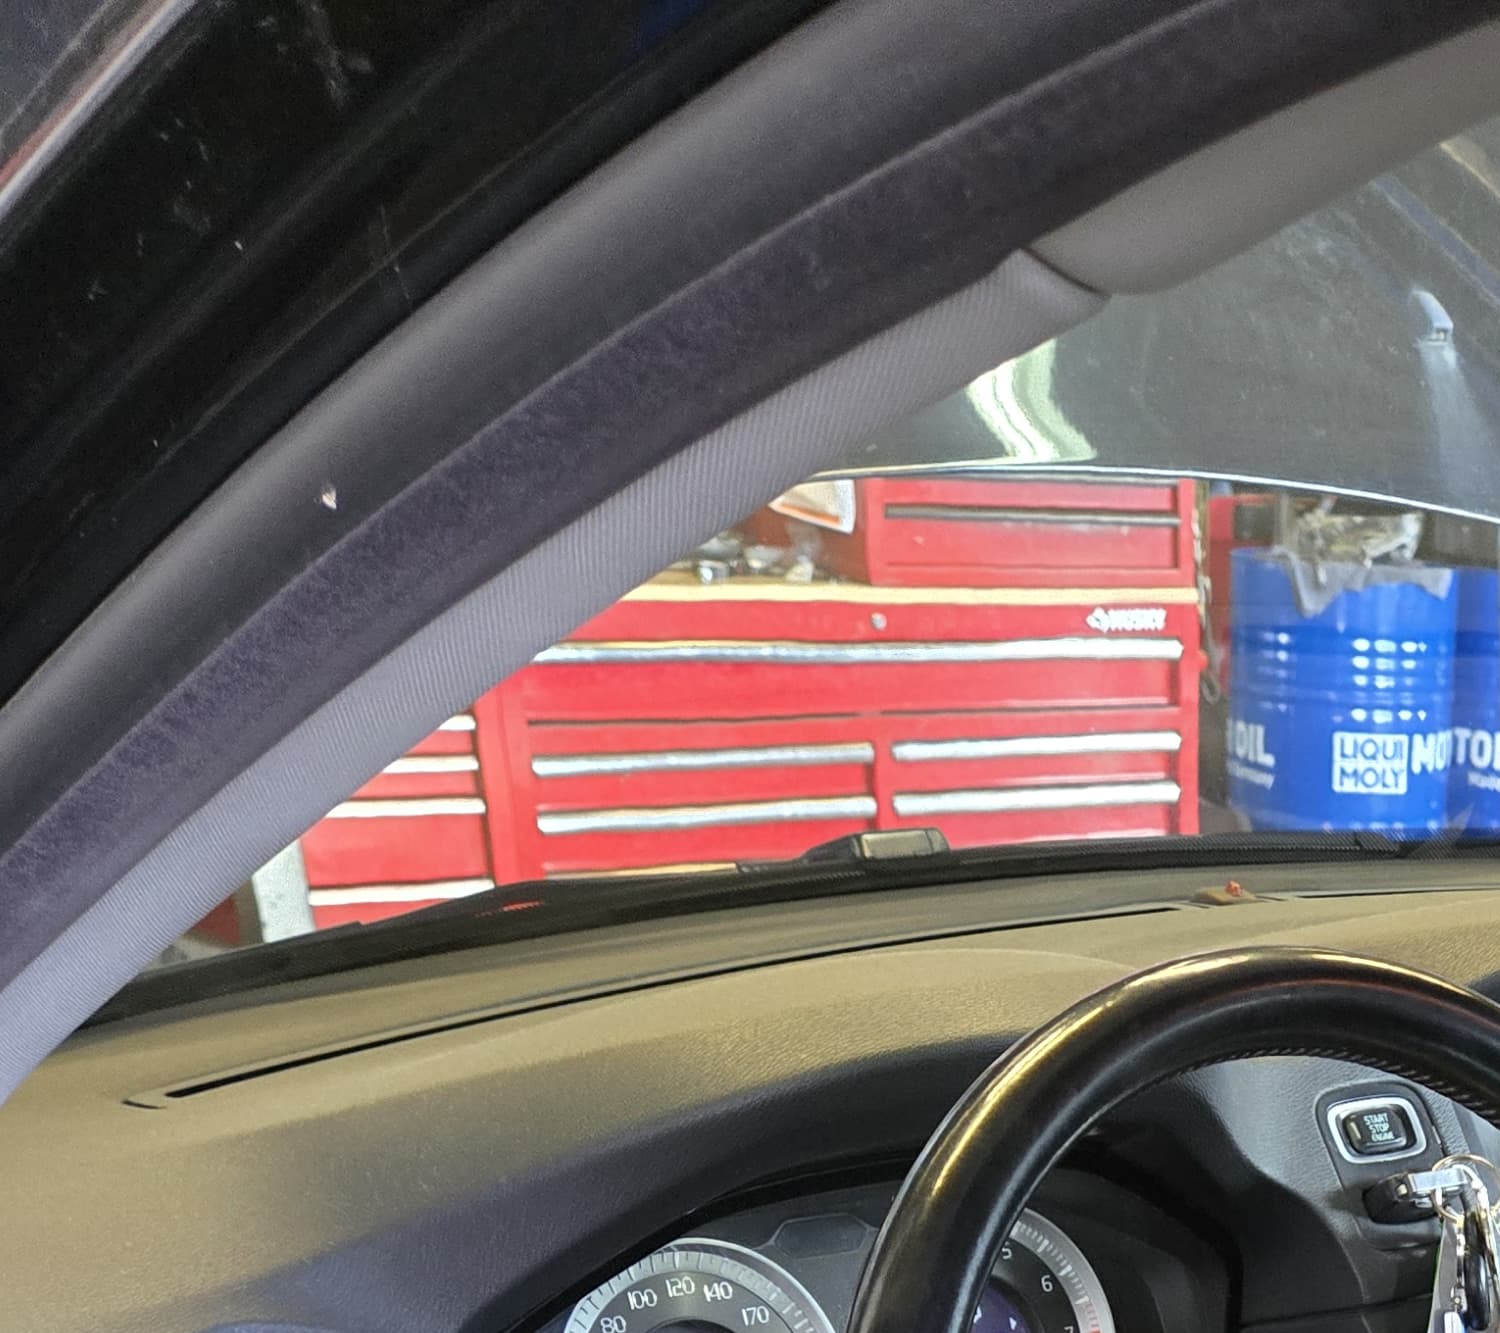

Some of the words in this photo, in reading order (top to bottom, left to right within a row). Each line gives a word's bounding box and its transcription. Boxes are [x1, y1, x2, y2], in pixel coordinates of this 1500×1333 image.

[1340, 736, 1404, 761] LIQUI
[1340, 767, 1404, 788] MOLY
[1363, 1112, 1389, 1126] START
[1369, 1122, 1390, 1133] STOP
[666, 1275, 695, 1297] 120
[703, 1281, 733, 1302] 140
[1041, 1274, 1053, 1293] 6
[628, 1288, 657, 1310] 100
[742, 1306, 769, 1326] 170
